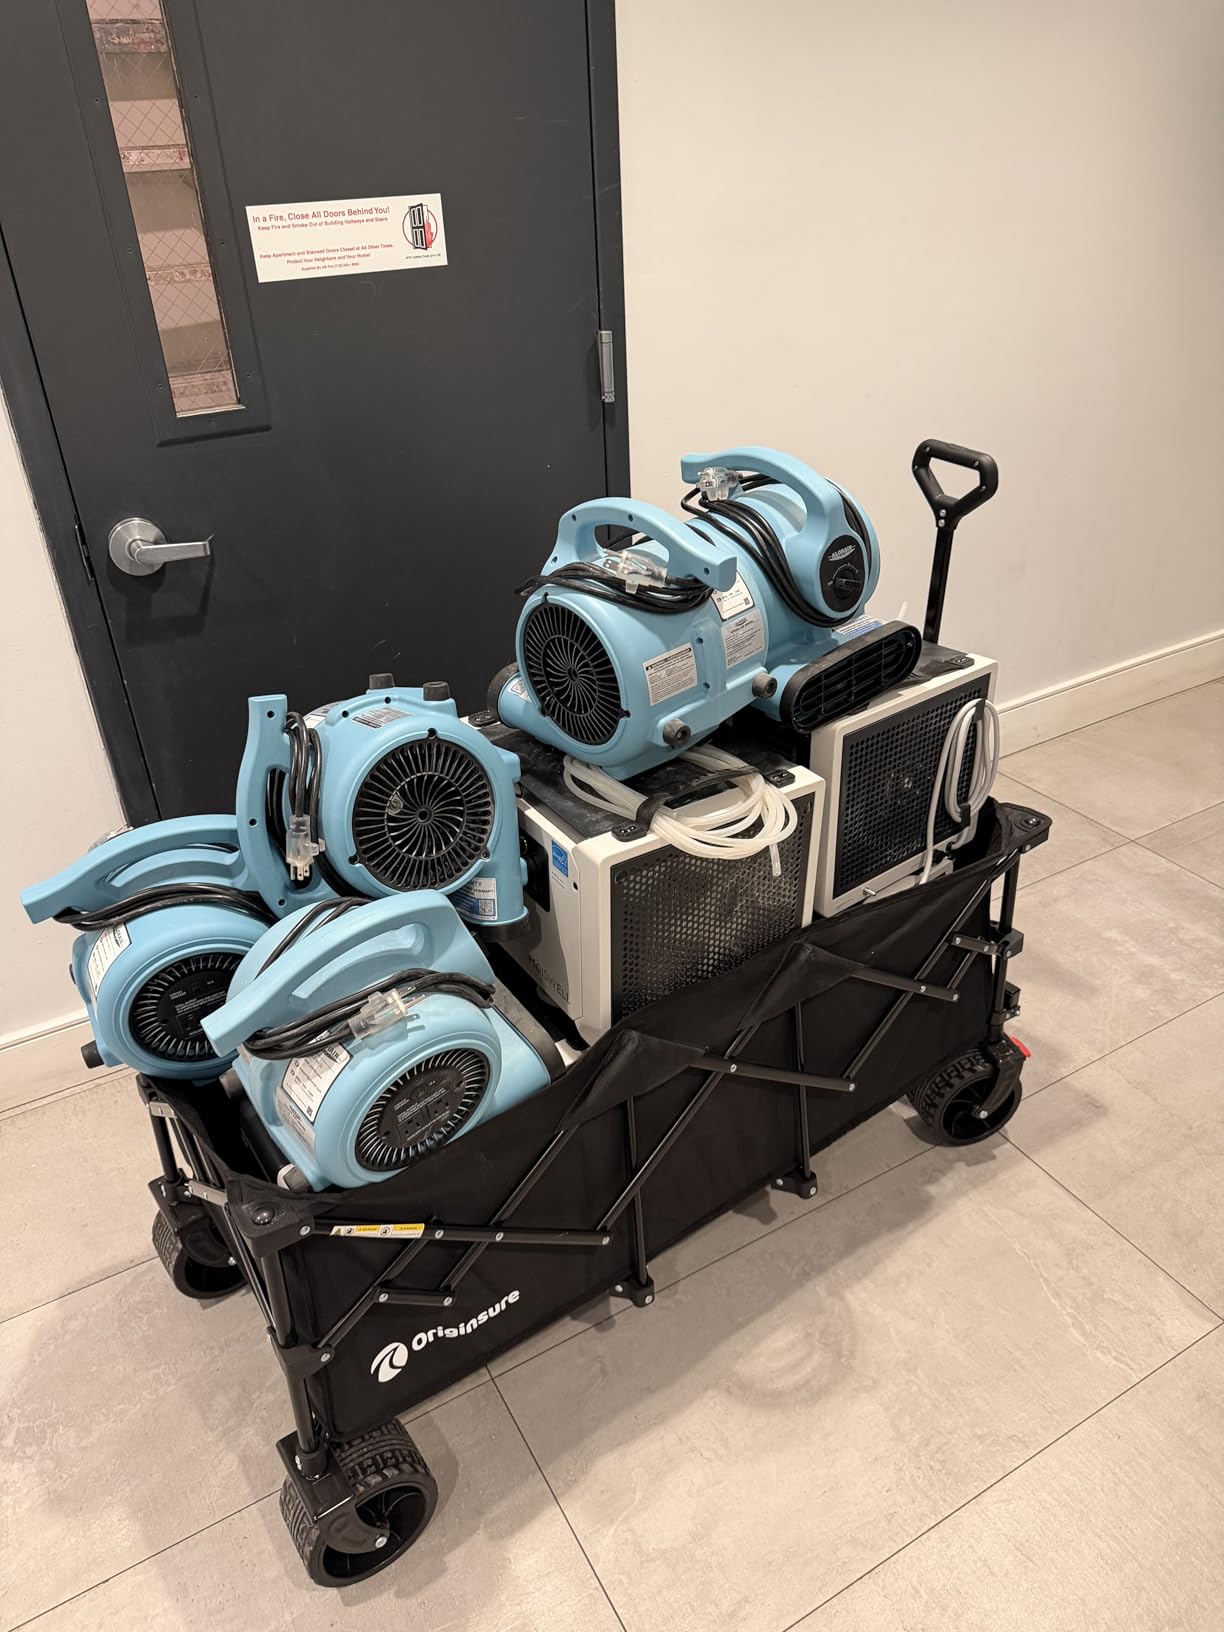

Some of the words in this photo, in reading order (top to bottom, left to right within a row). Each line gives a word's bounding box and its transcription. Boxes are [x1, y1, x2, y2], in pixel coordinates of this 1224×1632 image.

[269, 214, 286, 222] Fire,
[288, 212, 309, 220] Close
[312, 211, 322, 219] All
[323, 210, 346, 218] Doors
[347, 207, 373, 216] Behind
[374, 206, 390, 214] You!
[412, 1290, 520, 1352] Originsure
